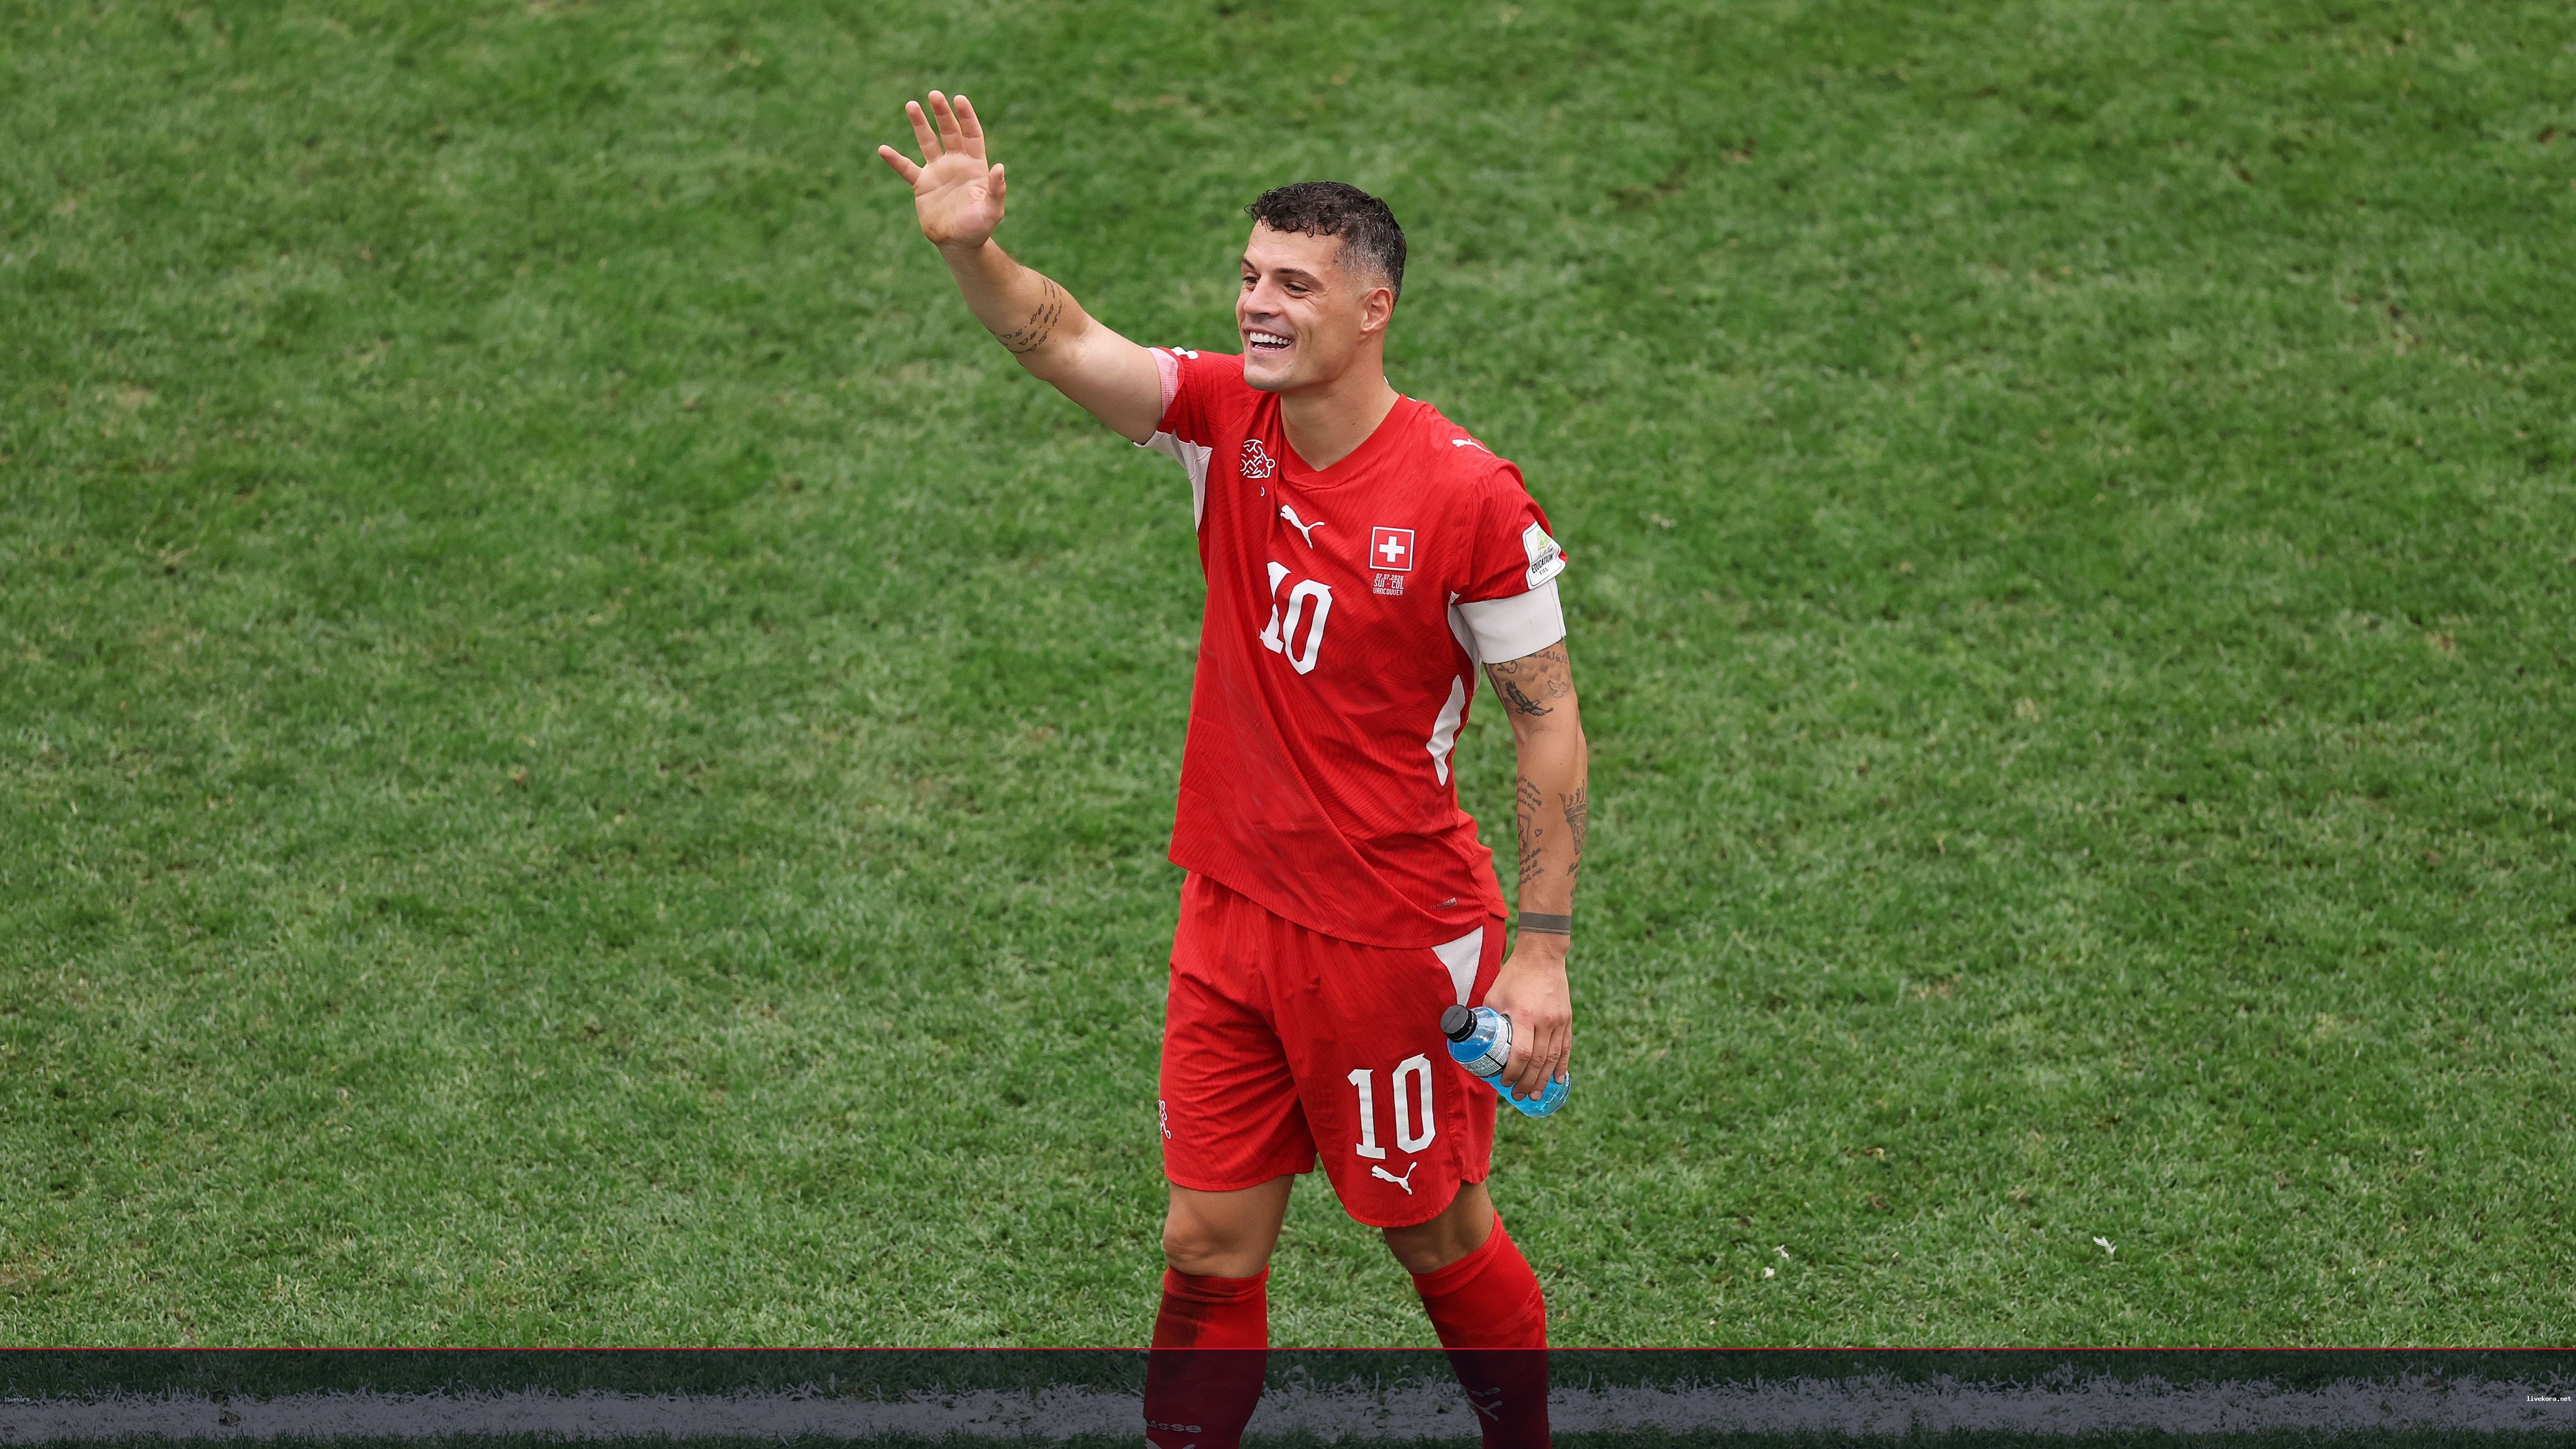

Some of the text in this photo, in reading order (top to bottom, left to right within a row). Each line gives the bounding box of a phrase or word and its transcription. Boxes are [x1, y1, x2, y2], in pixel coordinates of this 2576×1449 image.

[1531, 553, 1554, 573] EDUCATION
[1539, 567, 1548, 576] FIFA
[1376, 573, 1404, 581] 07.07.2026
[1374, 579, 1385, 587] SUI
[1392, 580, 1404, 589] COL
[1373, 587, 1403, 596] VANCOUVER
[1259, 561, 1333, 675] 10
[1347, 1053, 1436, 1160] 10
